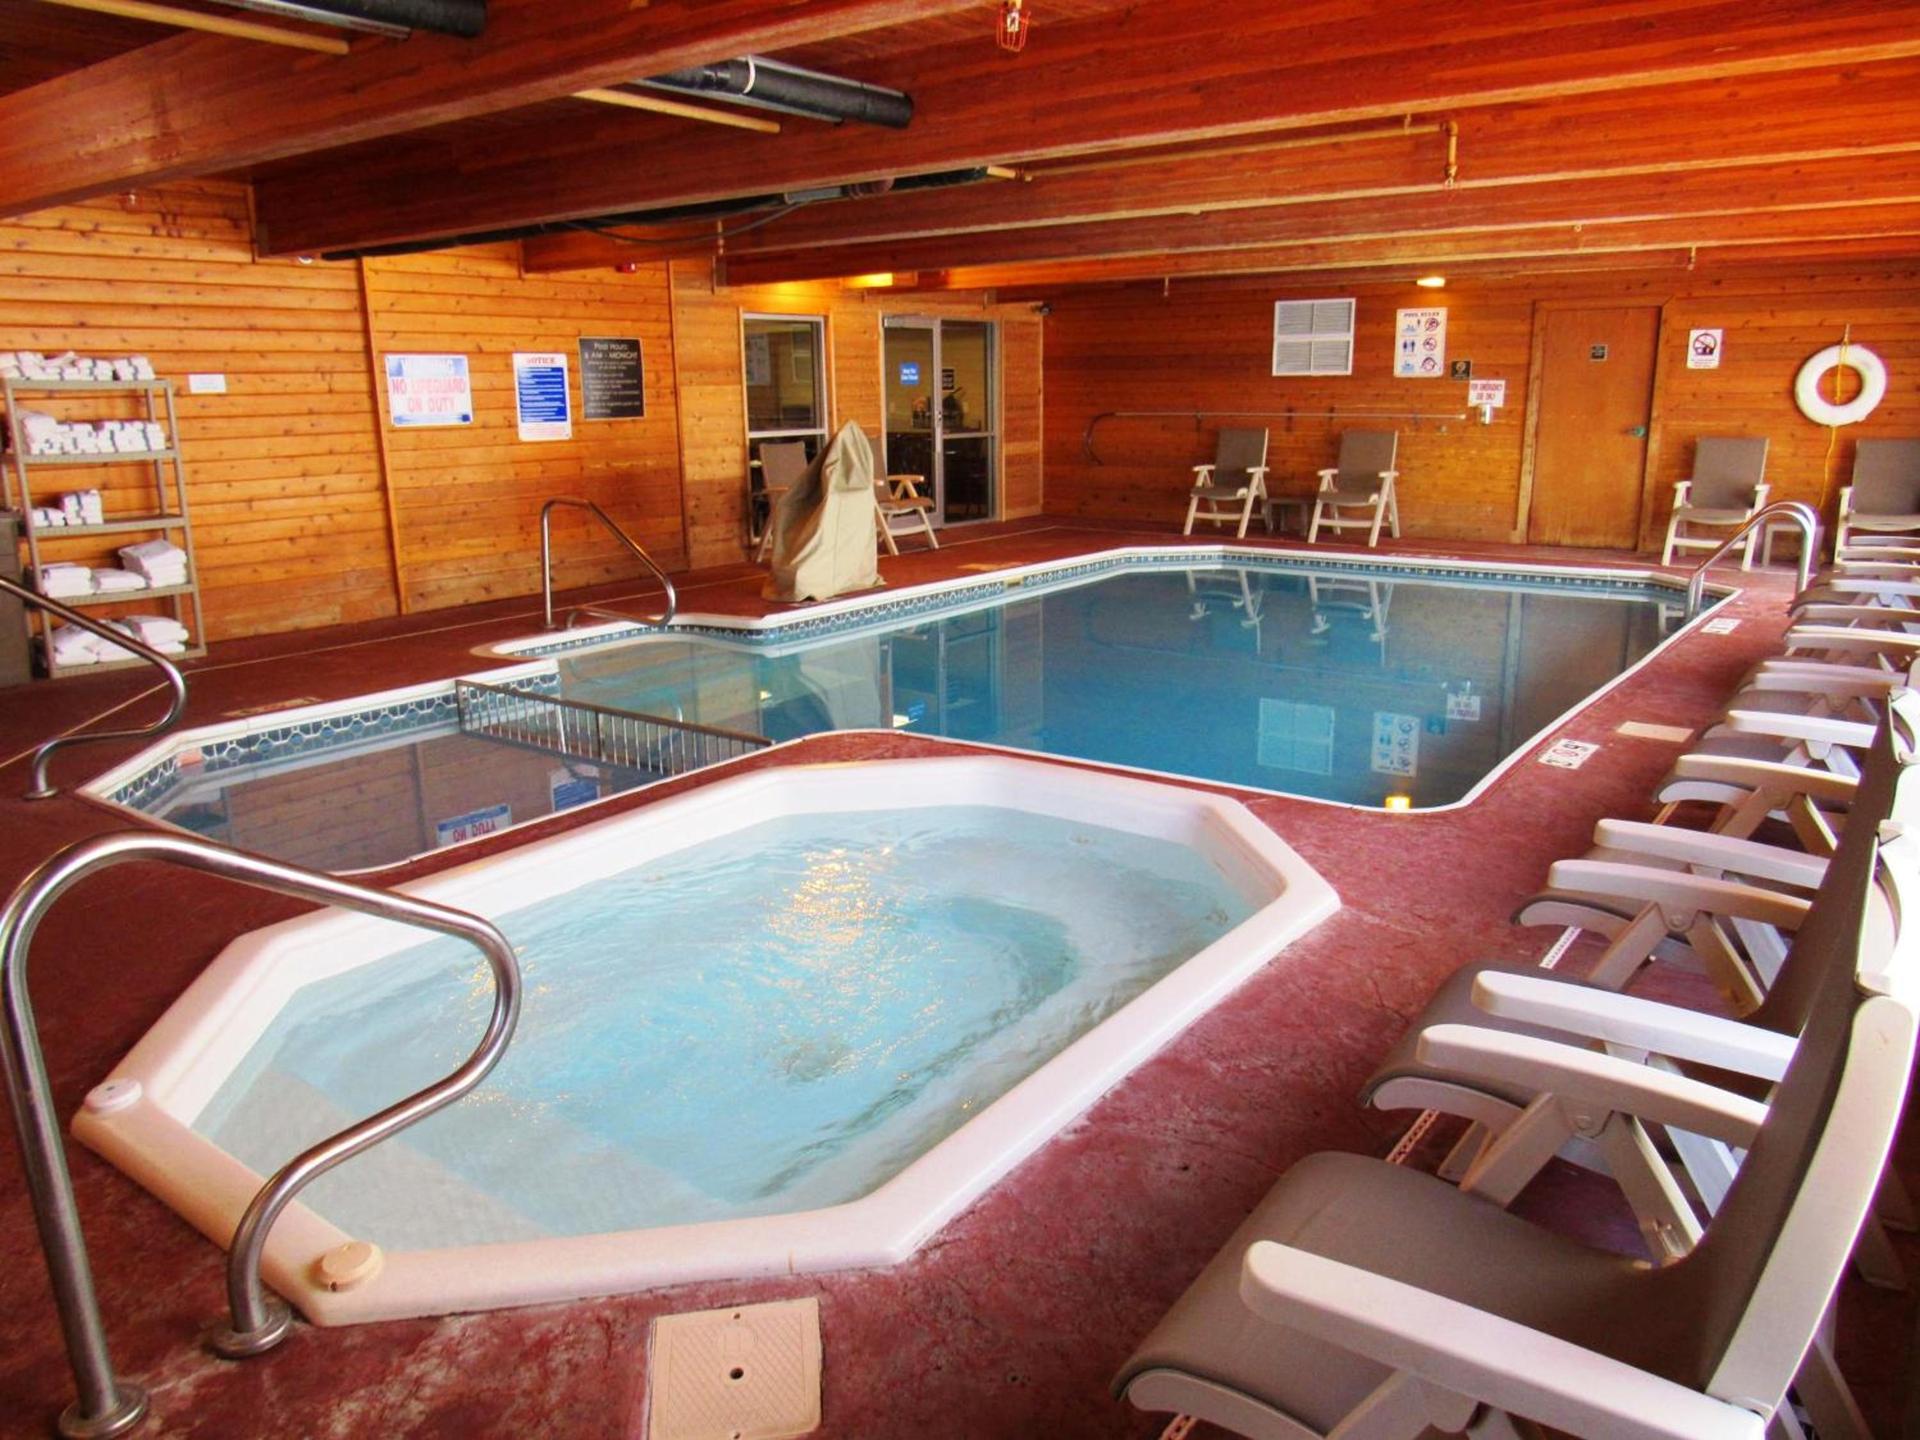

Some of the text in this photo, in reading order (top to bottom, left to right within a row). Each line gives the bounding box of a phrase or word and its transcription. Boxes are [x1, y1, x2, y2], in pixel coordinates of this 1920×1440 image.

[526, 356, 555, 365] NOTICE
[591, 351, 603, 359] AM
[392, 378, 466, 395] NO LIFEGUARD
[408, 397, 455, 412] ON DUTY
